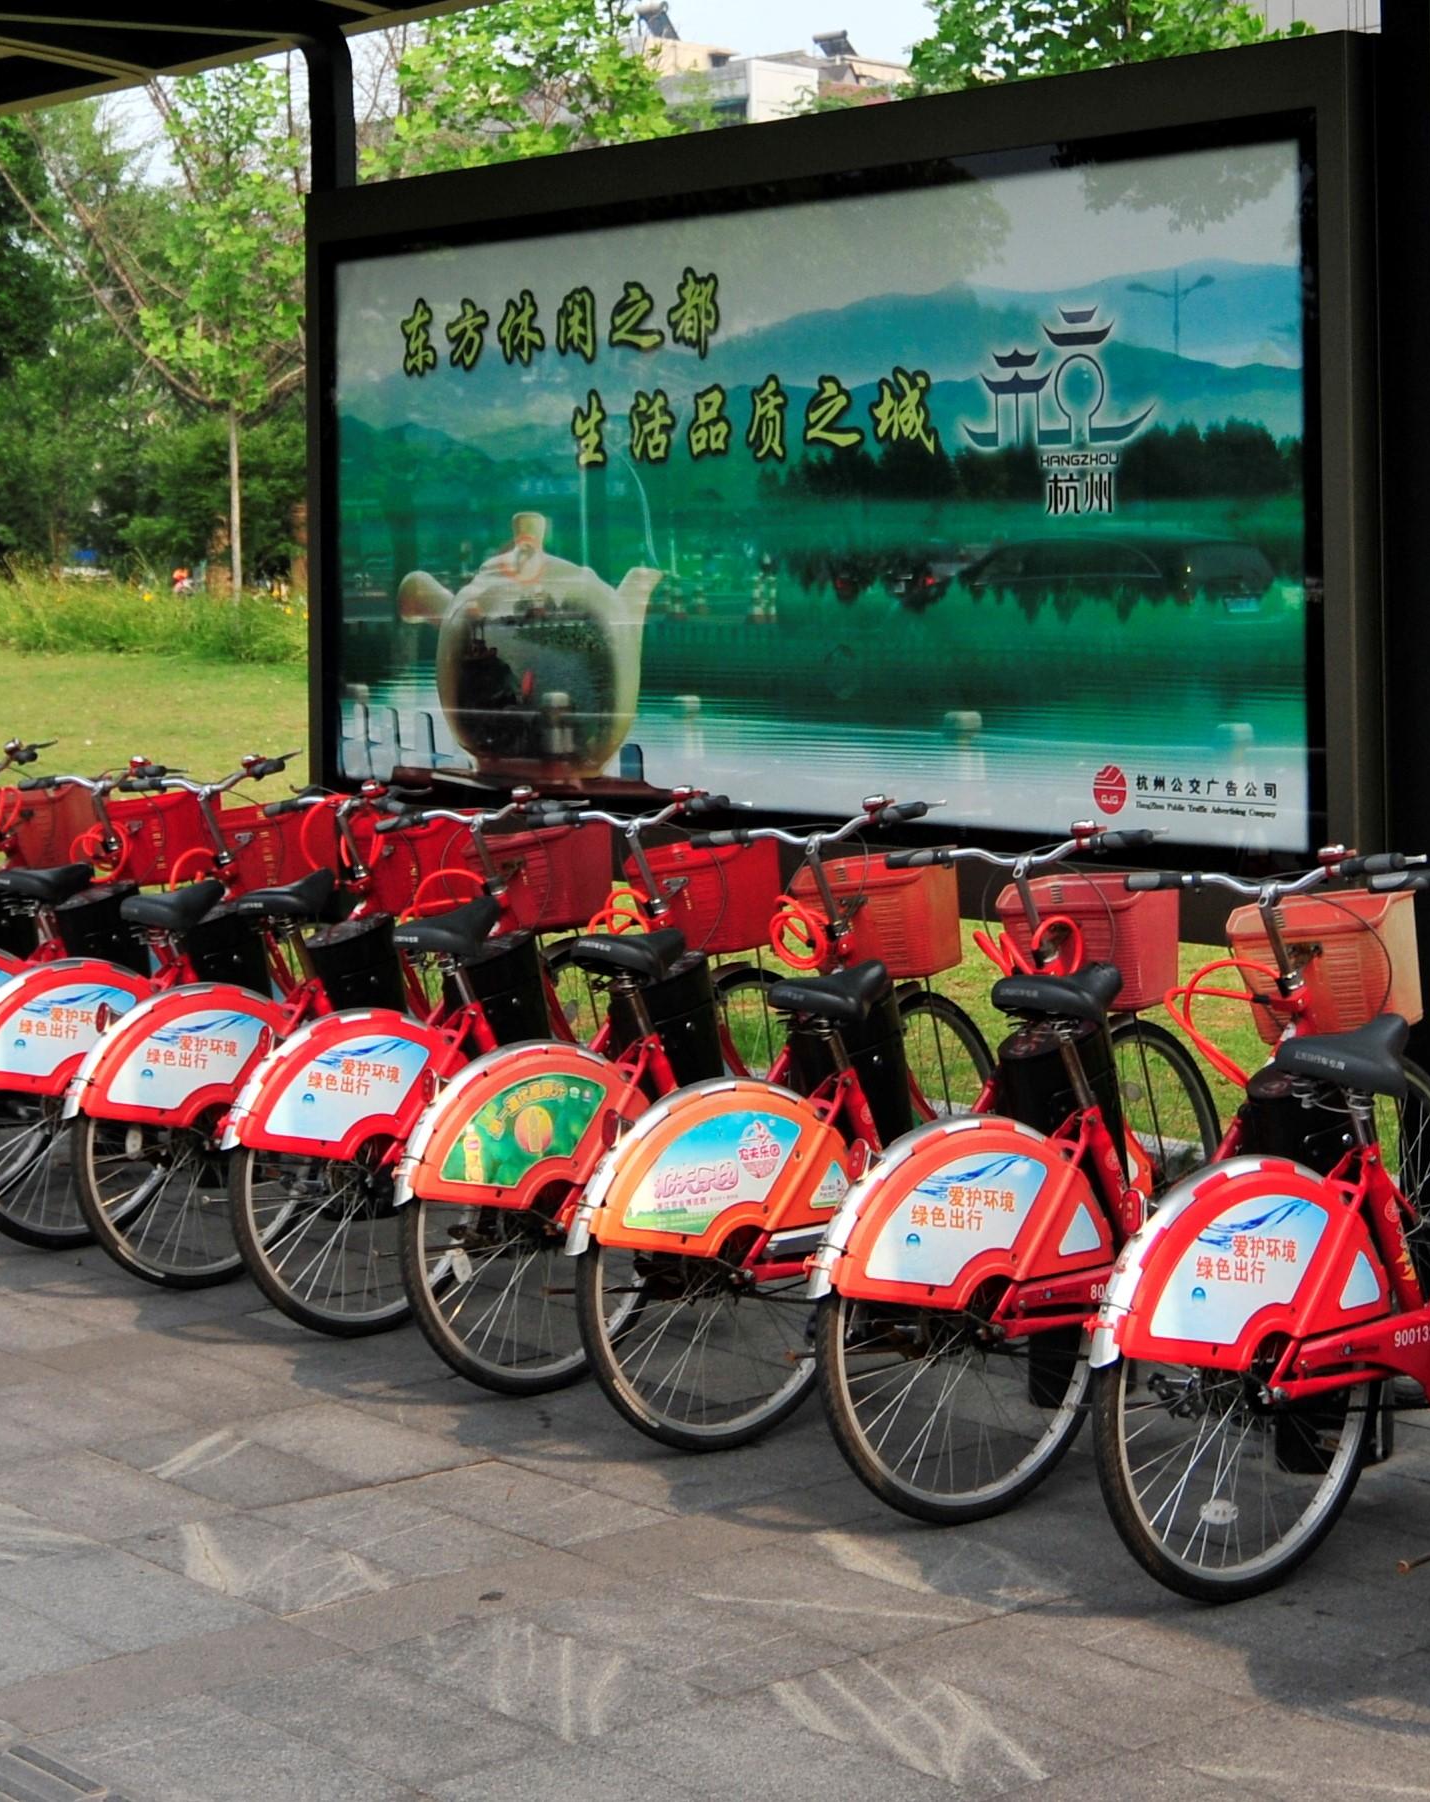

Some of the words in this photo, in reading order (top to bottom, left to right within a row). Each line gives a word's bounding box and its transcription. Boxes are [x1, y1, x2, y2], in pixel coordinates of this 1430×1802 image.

[400, 268, 719, 377] 东方休闲之都
[572, 366, 938, 468] 生活品质之城
[1039, 453, 1120, 468] HANGZHOU
[1045, 471, 1113, 515] 杭州
[1135, 774, 1278, 799] 杭州公交广告公司
[50, 1006, 96, 1024] 爱护环
[18, 1019, 79, 1040] 绿色出行
[146, 1048, 209, 1070] 绿色出行
[178, 1035, 239, 1058] 爱护环境
[307, 1071, 371, 1096] 绿色出行
[340, 1057, 401, 1085] 爱护环境
[948, 1187, 1016, 1214] 爱护环境
[909, 1203, 984, 1231] 绿色出行
[1232, 1234, 1298, 1264] 爱护环境
[1195, 1255, 1267, 1284] 绿色出行
